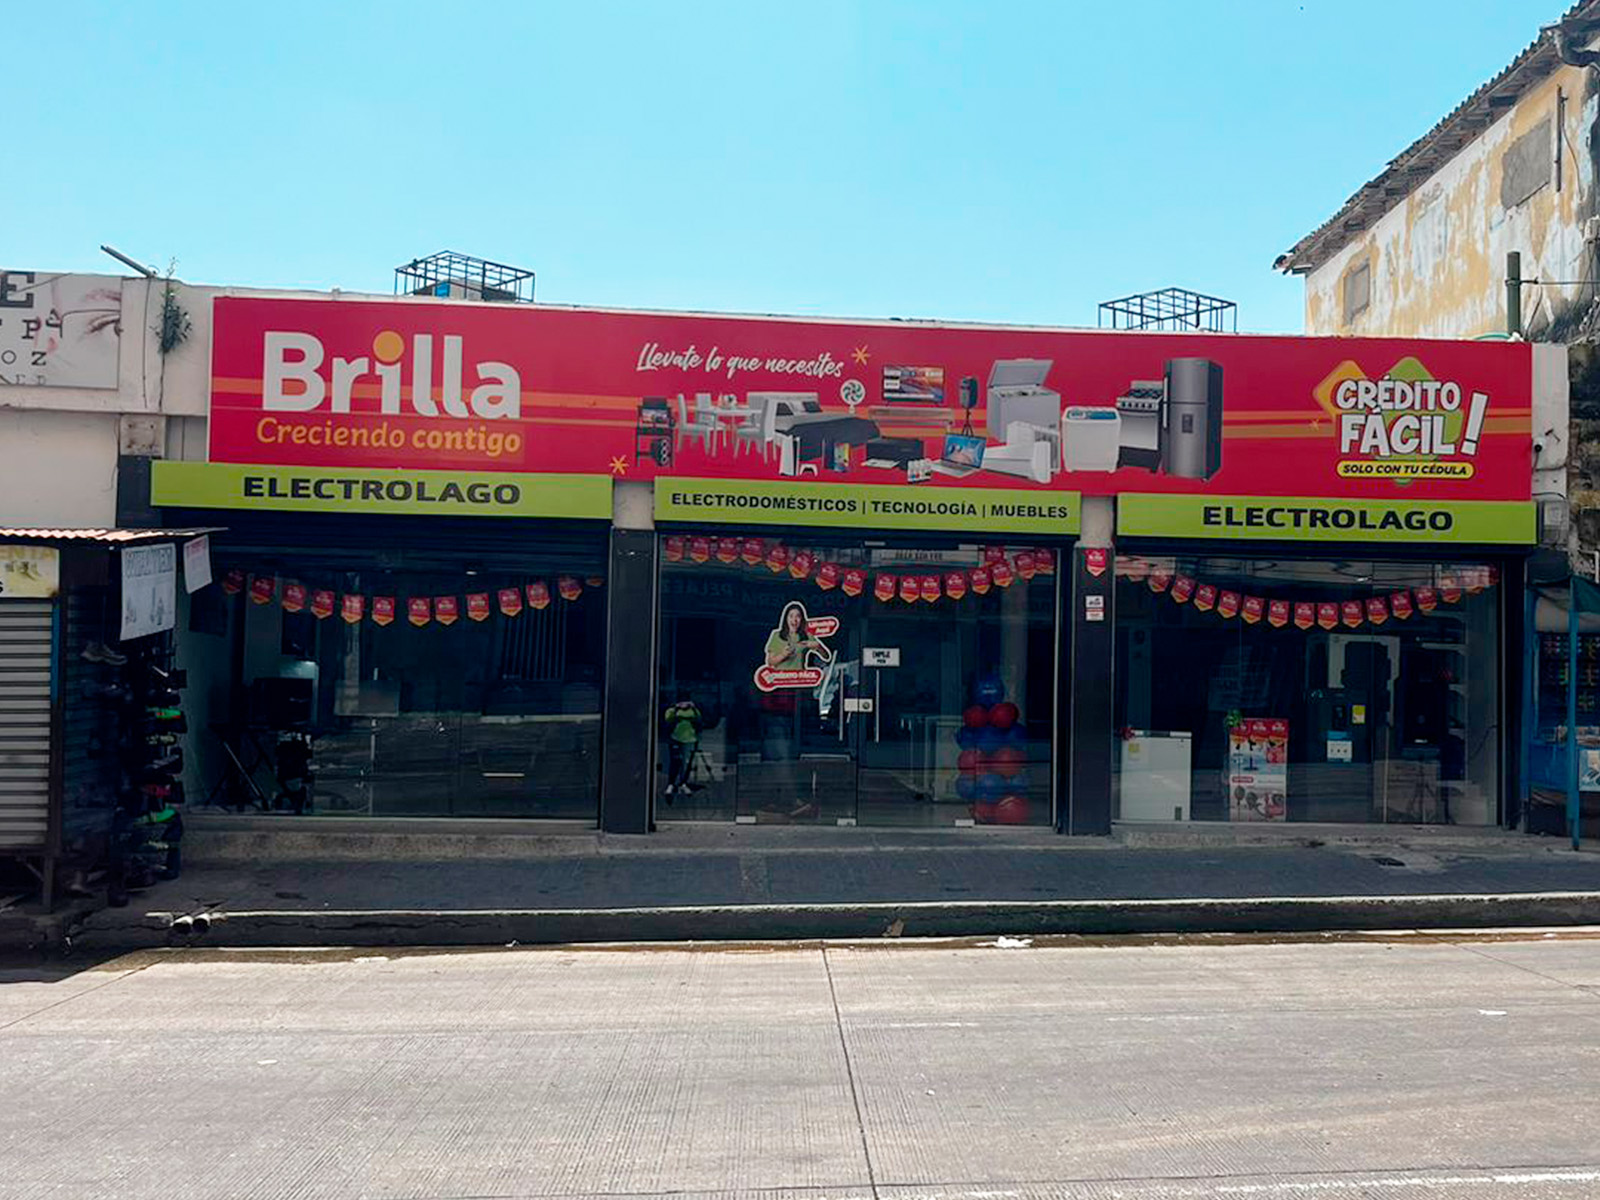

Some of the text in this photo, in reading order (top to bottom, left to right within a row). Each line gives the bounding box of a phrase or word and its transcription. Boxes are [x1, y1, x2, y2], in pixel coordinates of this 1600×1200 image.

[263, 331, 522, 420] Brilla
[637, 343, 844, 379] Llevate lo que necesites
[1336, 373, 1461, 411] CRÉDITO
[258, 417, 521, 455] Creciendo contigo
[1343, 464, 1467, 476] SOLO CON TU CÉDULA
[244, 477, 521, 504] ELECTROLAGO
[671, 491, 1068, 519] ELECTRODOMÉSTICOS TECNOLOGÍA MUEBLES
[1203, 506, 1453, 530] ELECTROLAGO
